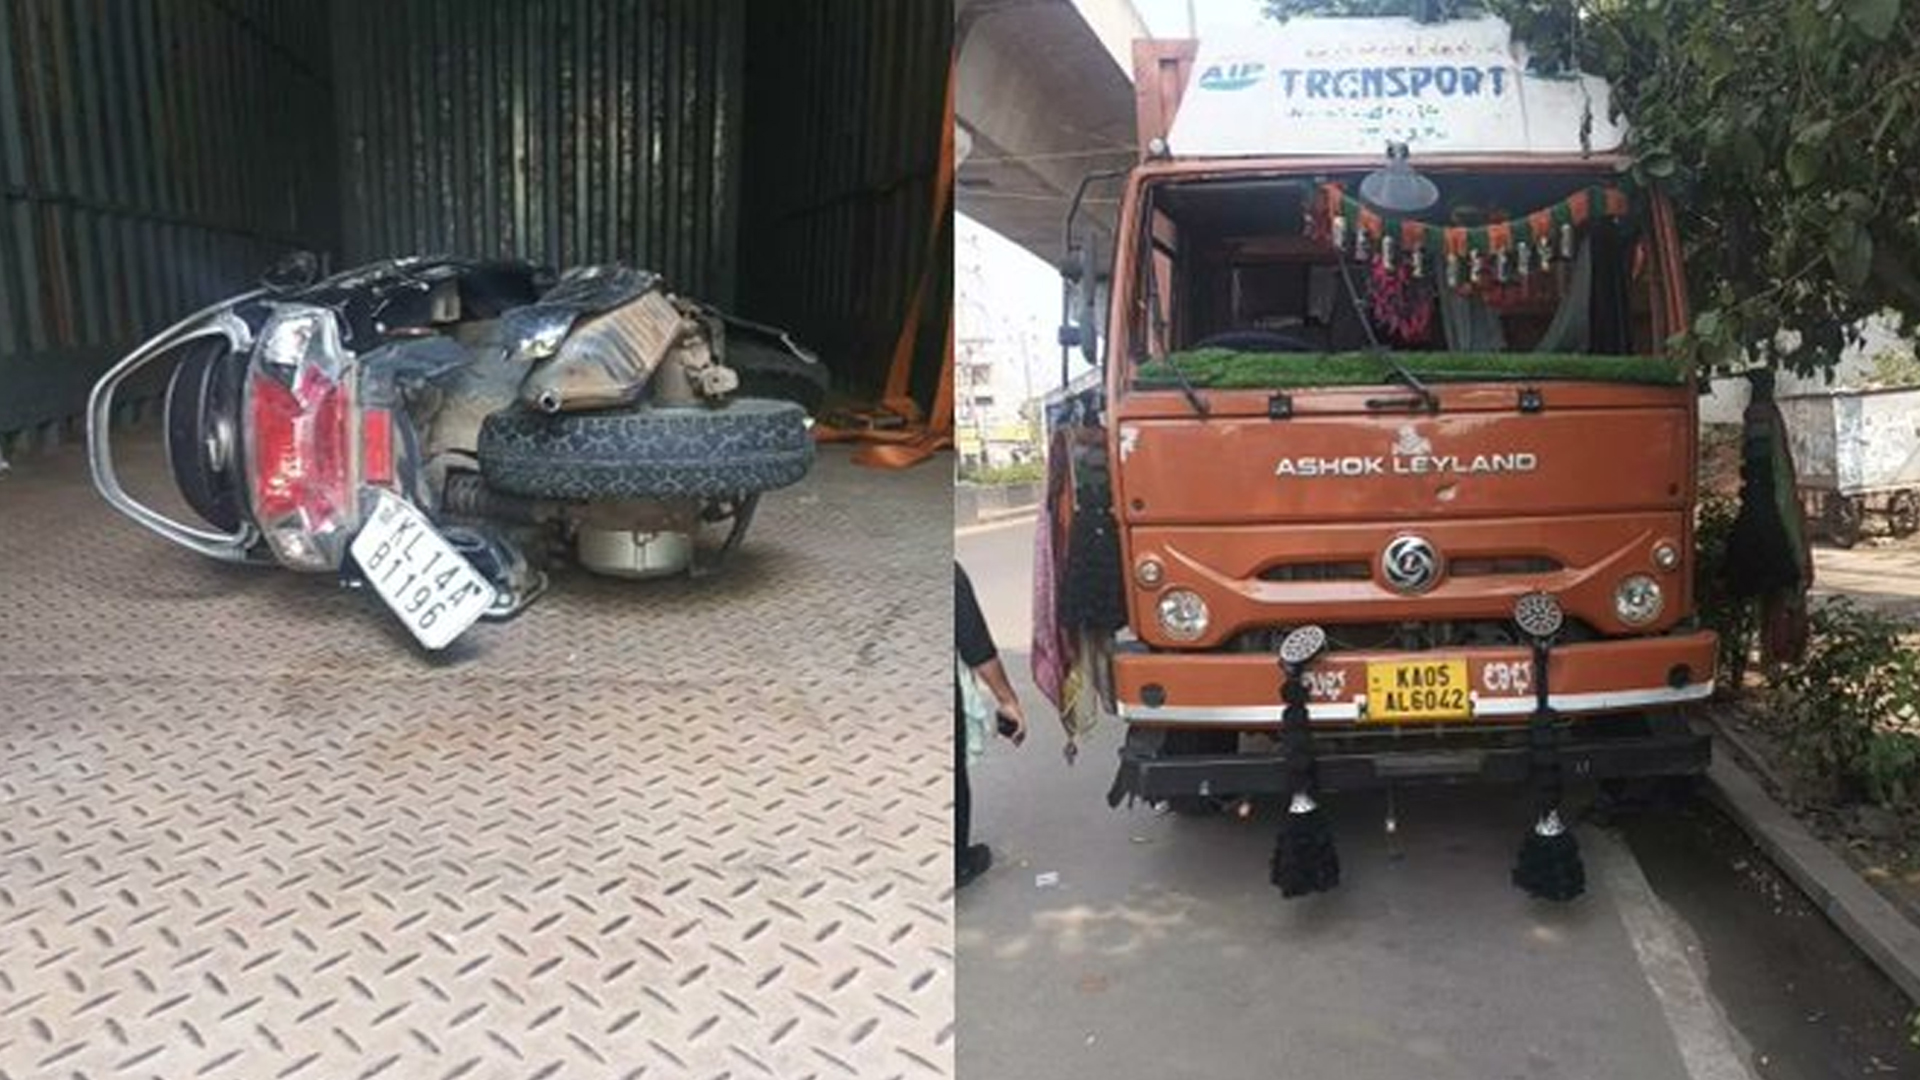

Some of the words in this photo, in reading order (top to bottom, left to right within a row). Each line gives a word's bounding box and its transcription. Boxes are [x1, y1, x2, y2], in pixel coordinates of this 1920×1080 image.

[1275, 457, 1384, 476] ASHOK
[1393, 453, 1538, 473] LEYLAND
[367, 541, 447, 629] B1196
[1396, 665, 1450, 688] KA05
[1384, 688, 1465, 713] AL6042
